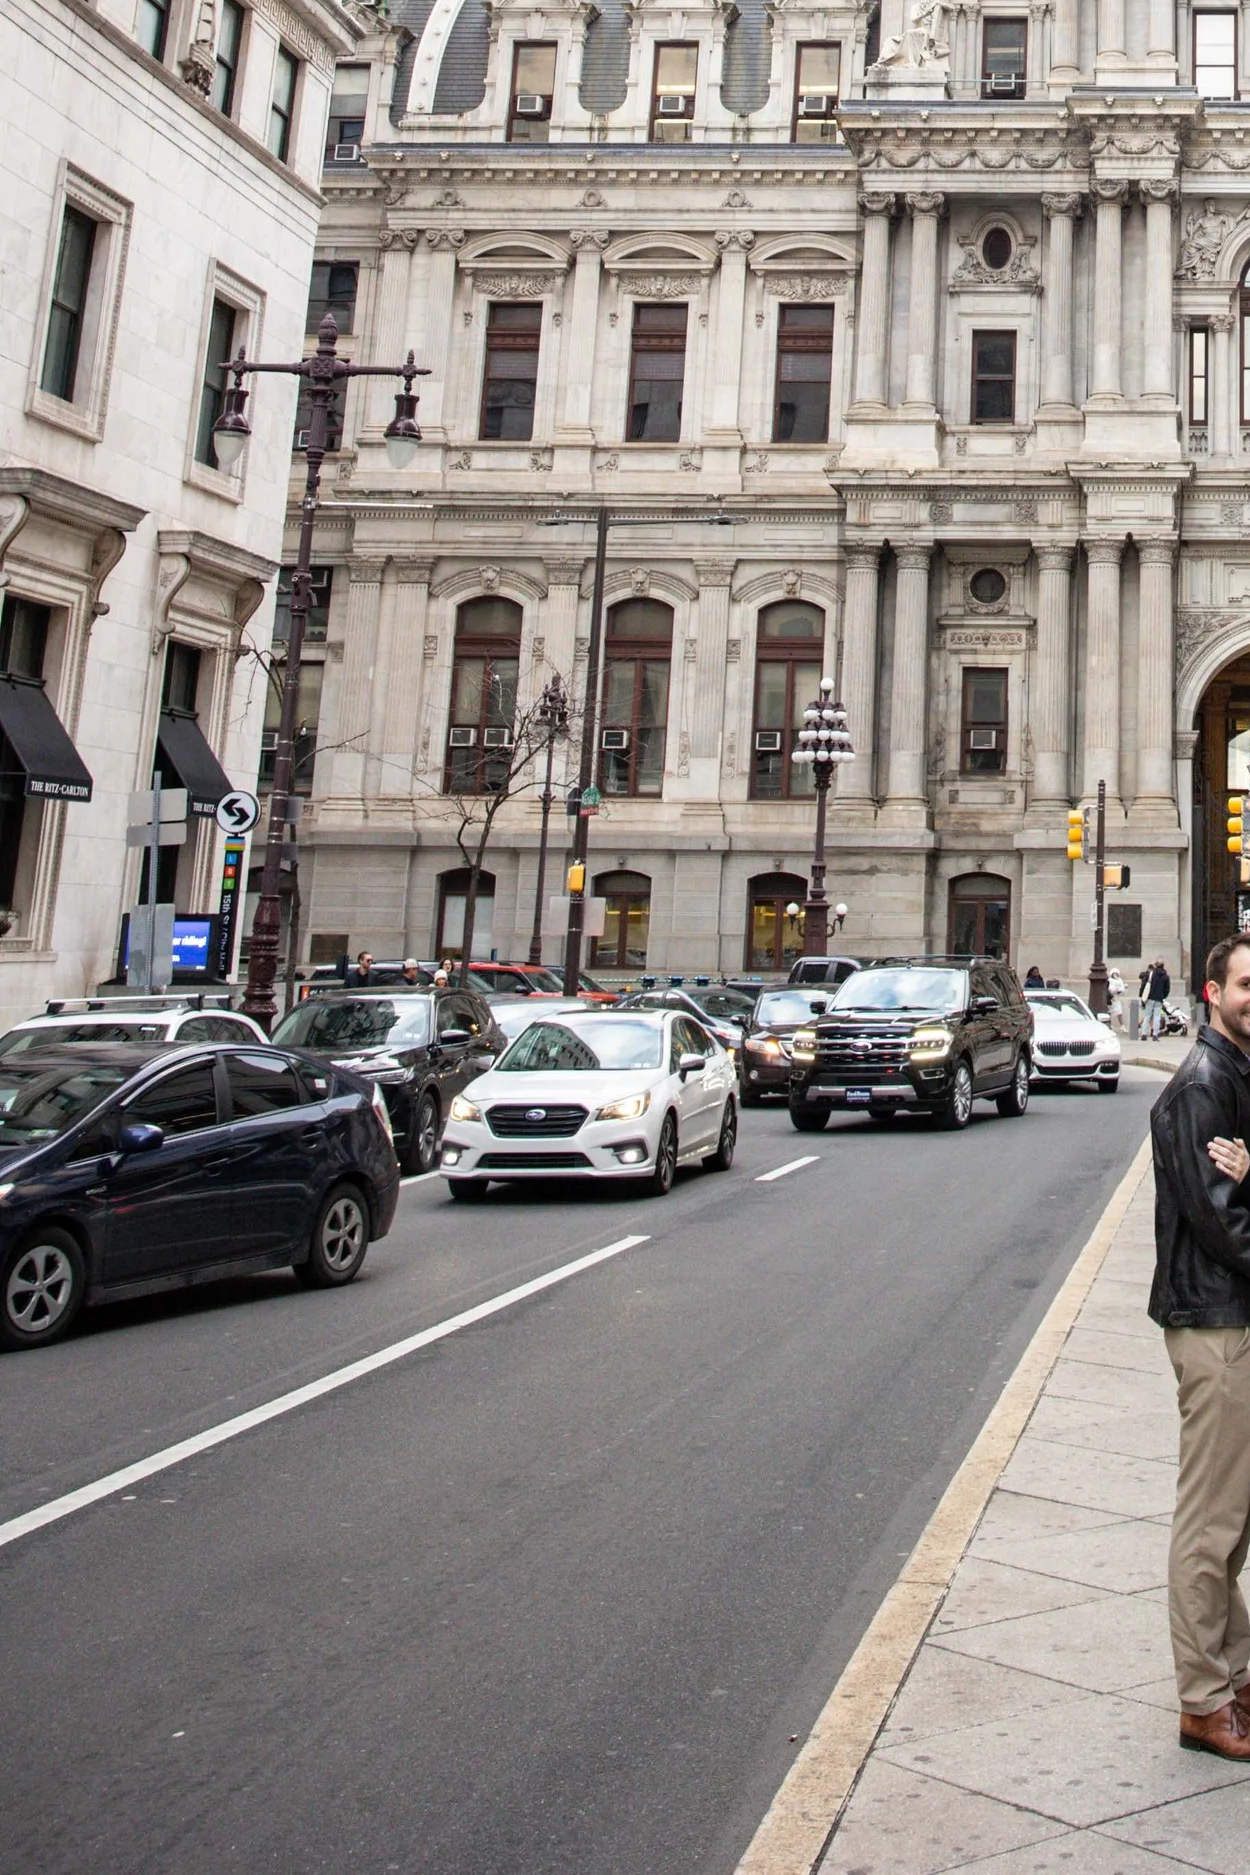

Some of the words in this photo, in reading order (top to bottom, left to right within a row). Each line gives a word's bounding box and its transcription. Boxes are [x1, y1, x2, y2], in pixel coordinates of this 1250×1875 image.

[31, 780, 44, 792] THE
[44, 781, 89, 797] RITZ-CARLTON
[193, 802, 203, 812] THE
[222, 894, 232, 913] 15th
